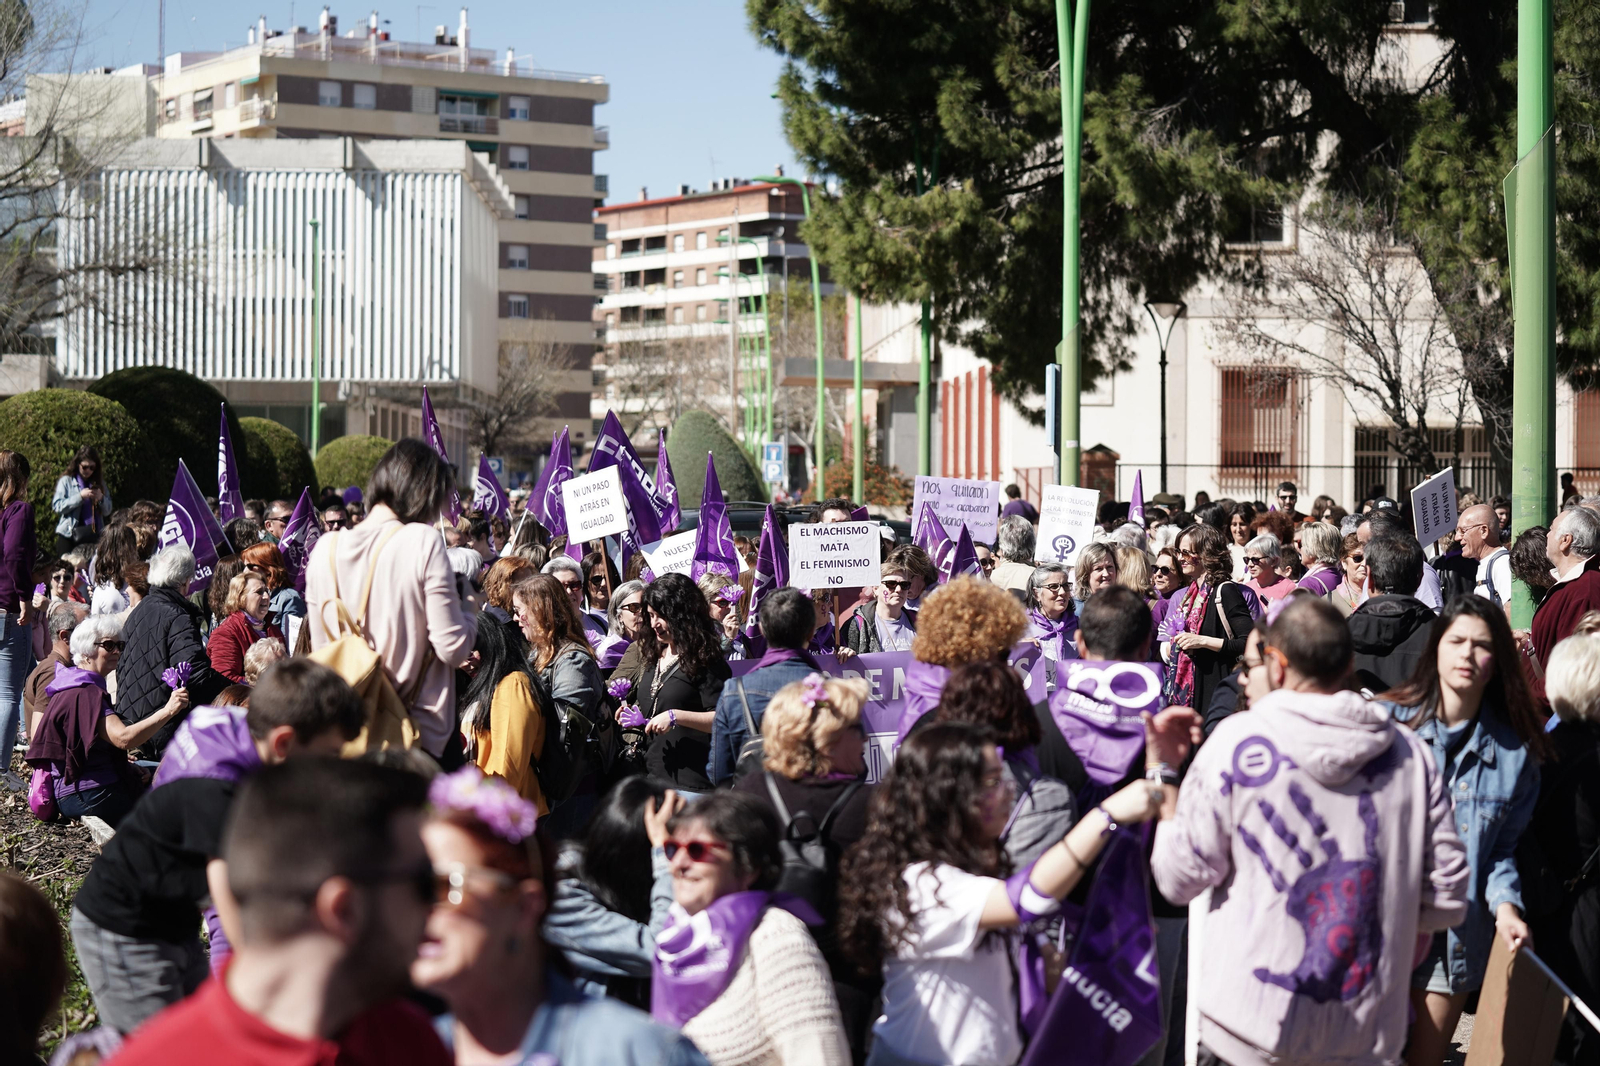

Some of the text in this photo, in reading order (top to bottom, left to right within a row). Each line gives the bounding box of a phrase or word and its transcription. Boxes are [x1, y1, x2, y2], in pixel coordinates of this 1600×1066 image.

[767, 464, 780, 479] P
[573, 480, 610, 498] NI UN PASO
[922, 481, 941, 494] nos
[1441, 482, 1447, 492] NI
[1442, 492, 1449, 504] UN
[580, 497, 610, 513] ATRÁS EN
[1431, 492, 1441, 527] ATRÁS EN
[1062, 507, 1094, 518] FEMINISTA
[1421, 497, 1430, 534] IGUALDAD
[580, 514, 615, 530] IGUALDAD
[800, 526, 869, 537] EL MACHISMO
[820, 543, 850, 552] MATA
[662, 558, 694, 573] DEREC
[800, 558, 870, 569] EL FEMINISMO
[828, 576, 844, 585] NO
